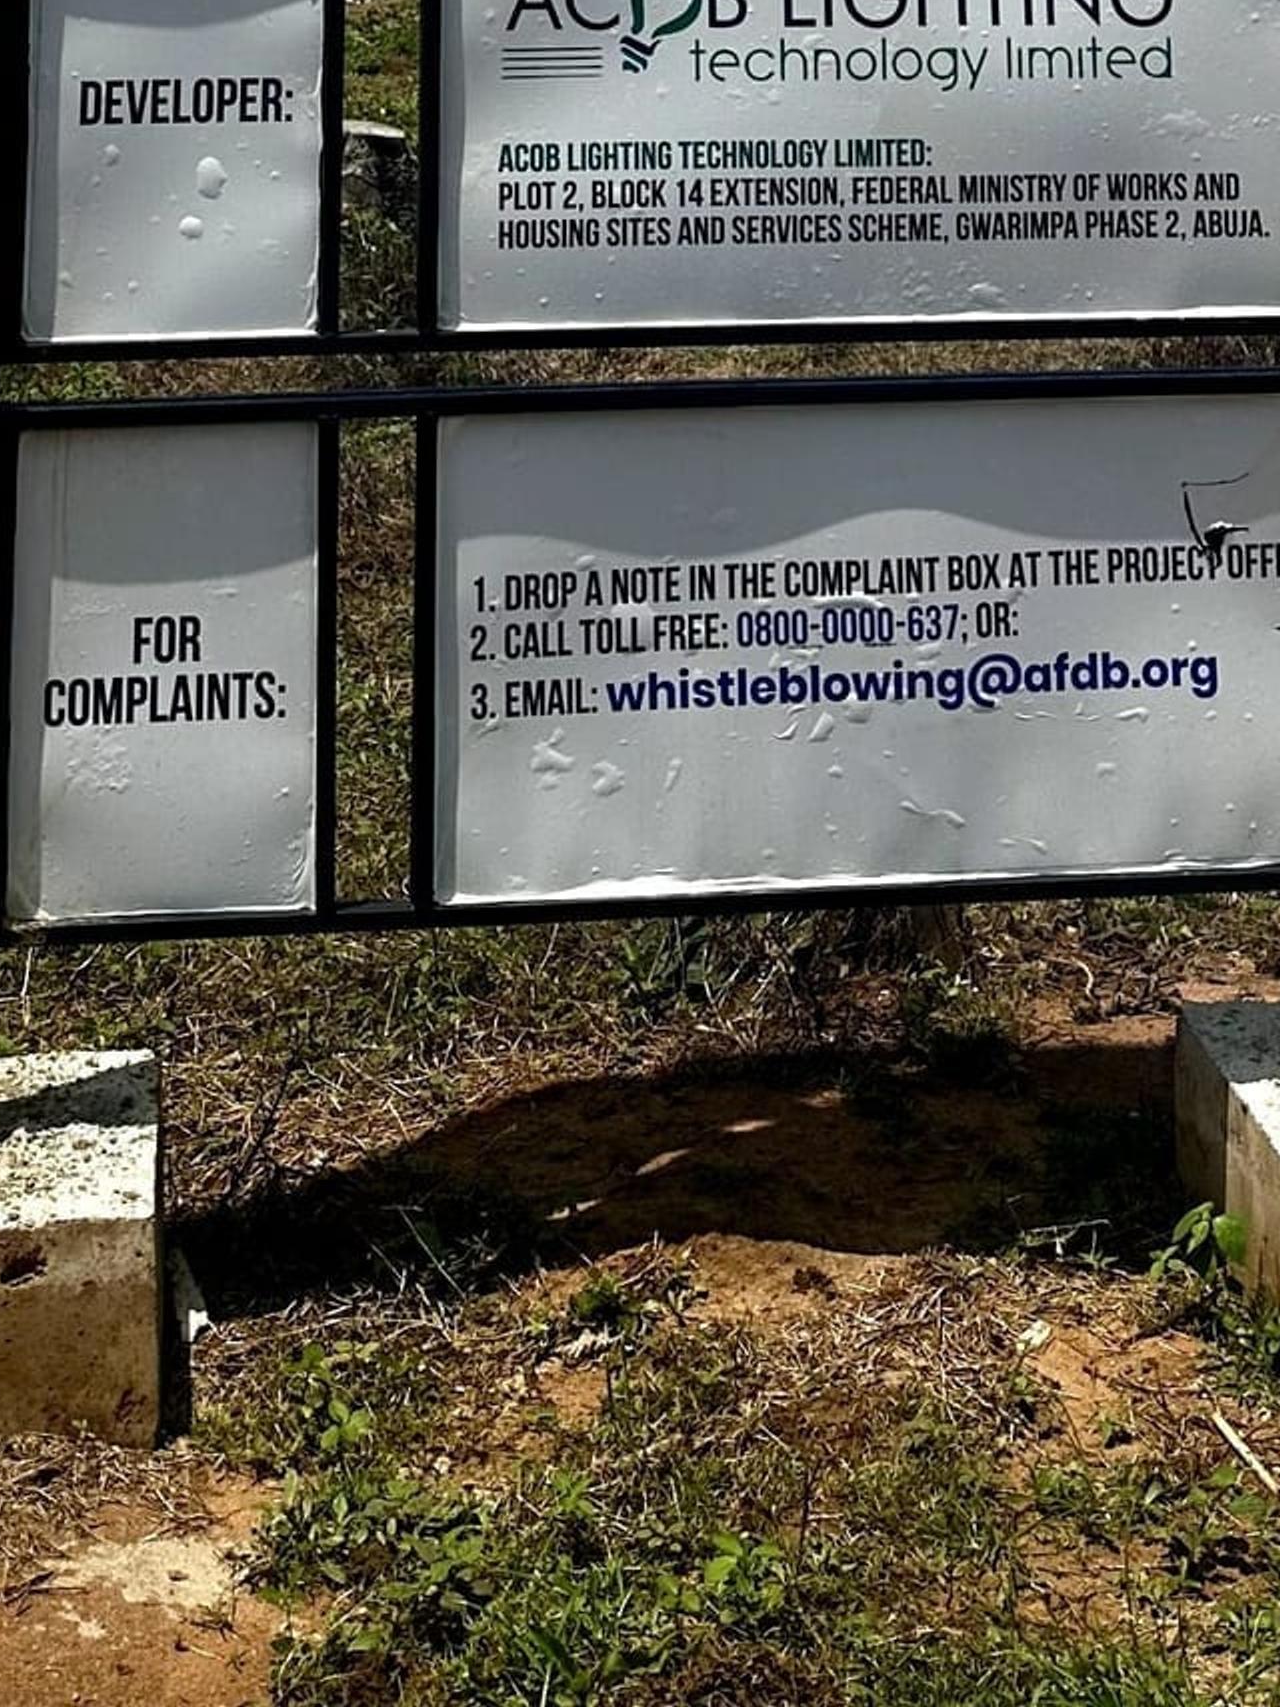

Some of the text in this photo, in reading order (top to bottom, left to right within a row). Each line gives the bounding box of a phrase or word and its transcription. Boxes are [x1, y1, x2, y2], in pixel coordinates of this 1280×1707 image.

[688, 36, 1174, 92] technology limited
[79, 76, 294, 126] DEVELOPER:
[497, 138, 933, 173] ACOB LIGHTING TECHNOLOGY LIMITED:
[498, 172, 1240, 213] PLOT 2, BLOCK 14 EXTENSION, FEDERAL MINISTRY OF WORKS AND
[497, 209, 1271, 251] HOUSING SITES AND SERVICES SCHEME, GWARIMPA PHASE 2, ABUJA.
[473, 575, 496, 612] 1.
[505, 572, 577, 611] DROP
[584, 570, 603, 607] A
[611, 566, 681, 605] NOTE
[689, 564, 716, 601] IN
[724, 561, 776, 599] THE
[784, 556, 939, 596] COMPLAINT
[948, 553, 1000, 590] BOX
[1008, 551, 1042, 588] AT
[1049, 549, 1100, 586] THE
[1107, 545, 1221, 584] PROJECT
[133, 615, 201, 664] FOR
[470, 601, 1019, 661] 2. CALL TOLL FREE: 0800-0000-637; OR:
[43, 670, 287, 727] COMPLAINTS:
[470, 652, 1219, 719] 3. EMAIL: whistleblowing@afdb.org
